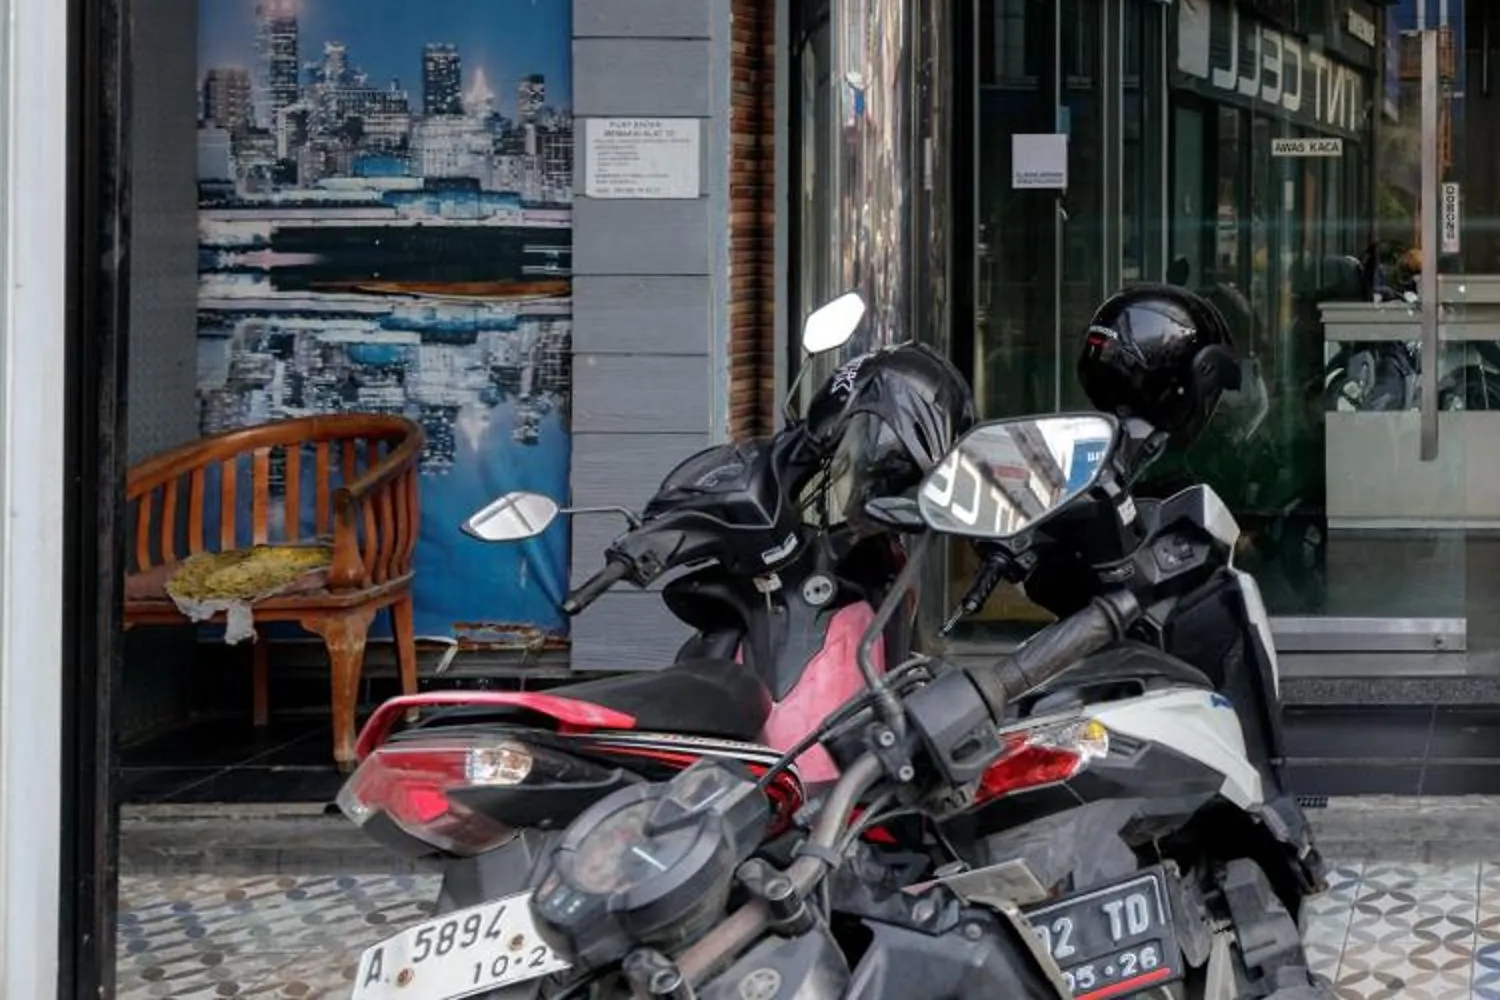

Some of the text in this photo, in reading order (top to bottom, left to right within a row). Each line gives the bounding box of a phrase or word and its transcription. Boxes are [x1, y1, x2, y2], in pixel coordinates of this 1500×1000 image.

[1275, 142, 1340, 153] AWAS KACA
[412, 905, 507, 964] 5894
[1102, 893, 1150, 942] TD
